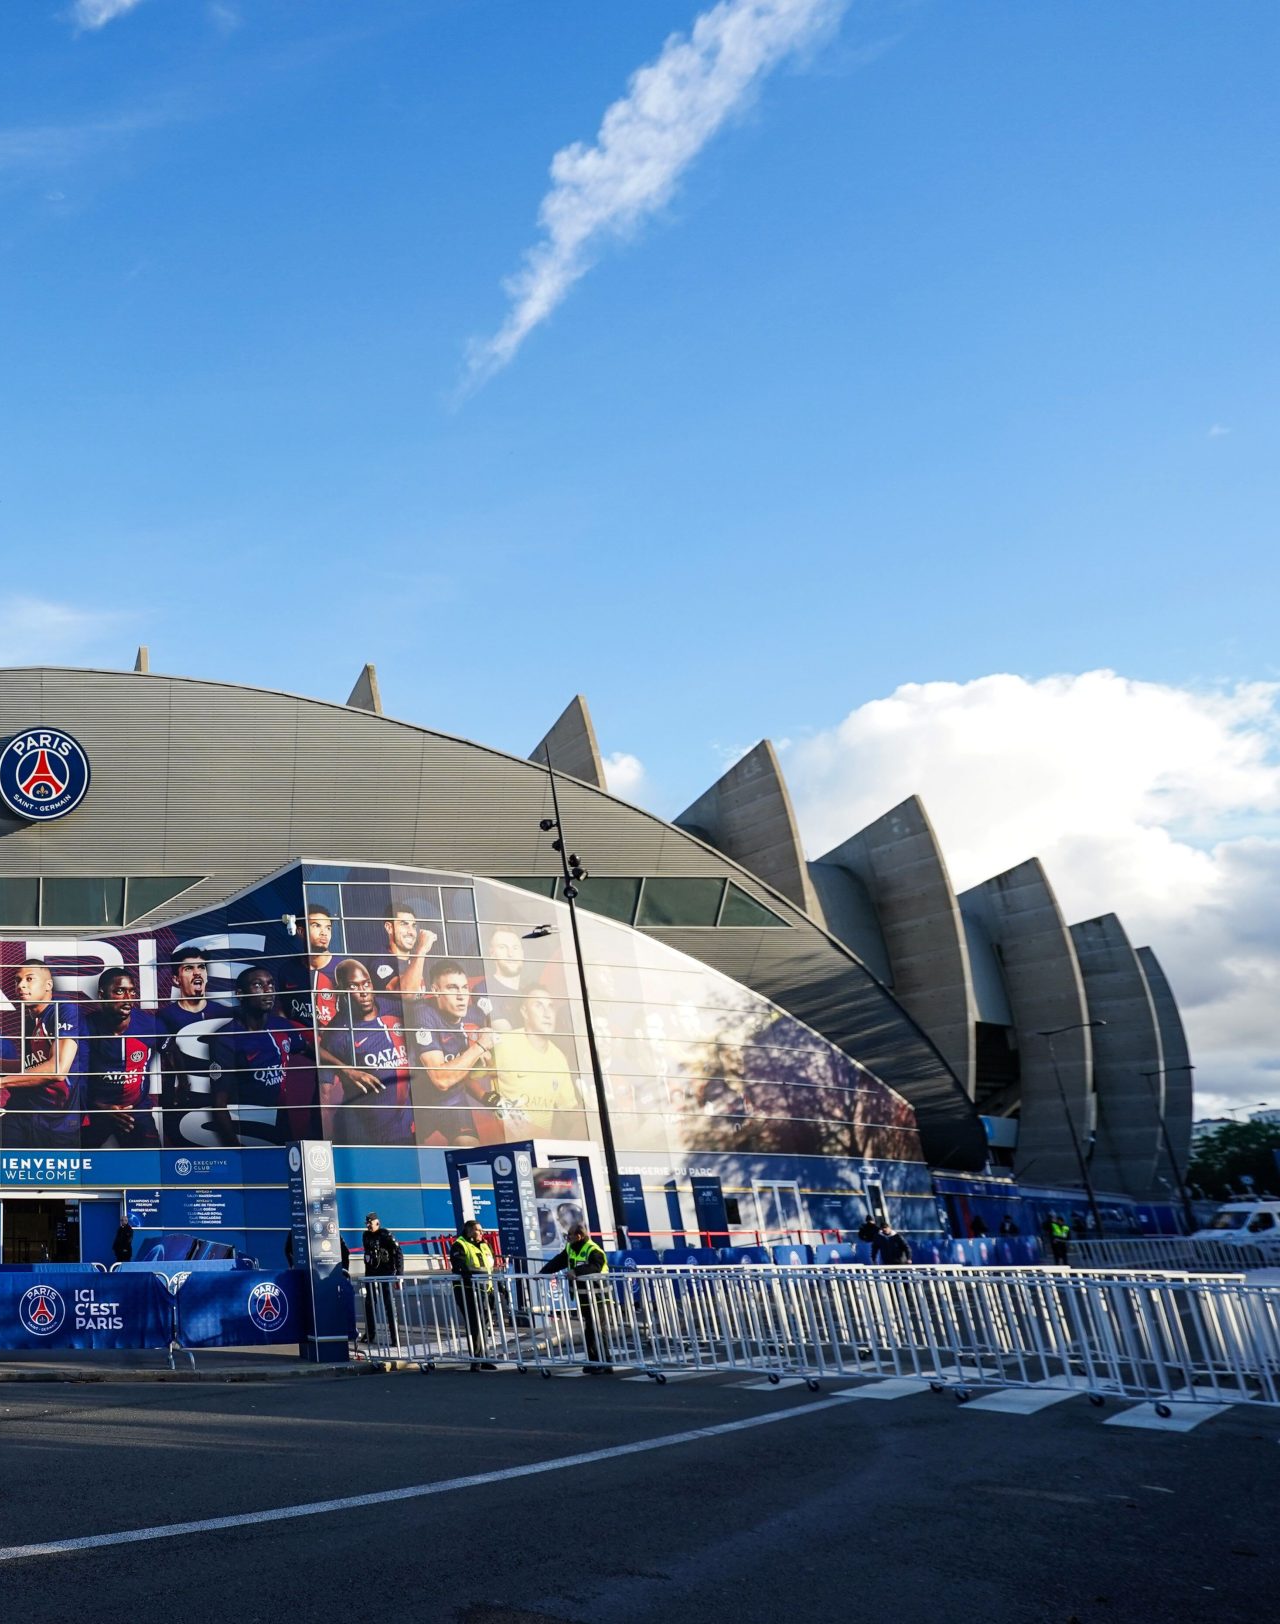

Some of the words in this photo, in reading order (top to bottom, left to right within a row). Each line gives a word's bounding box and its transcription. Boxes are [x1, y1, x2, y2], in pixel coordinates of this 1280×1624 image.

[12, 734, 72, 756] PARIS
[365, 1045, 407, 1067] QATAR
[498, 1160, 508, 1171] L
[5, 1170, 76, 1180] WELCOME
[690, 1168, 713, 1176] PARC
[26, 1287, 57, 1300] PARIS
[75, 1289, 94, 1301] ICI
[254, 1285, 280, 1297] PARIS
[75, 1303, 119, 1316] C'EST
[75, 1317, 124, 1330] PARIS
